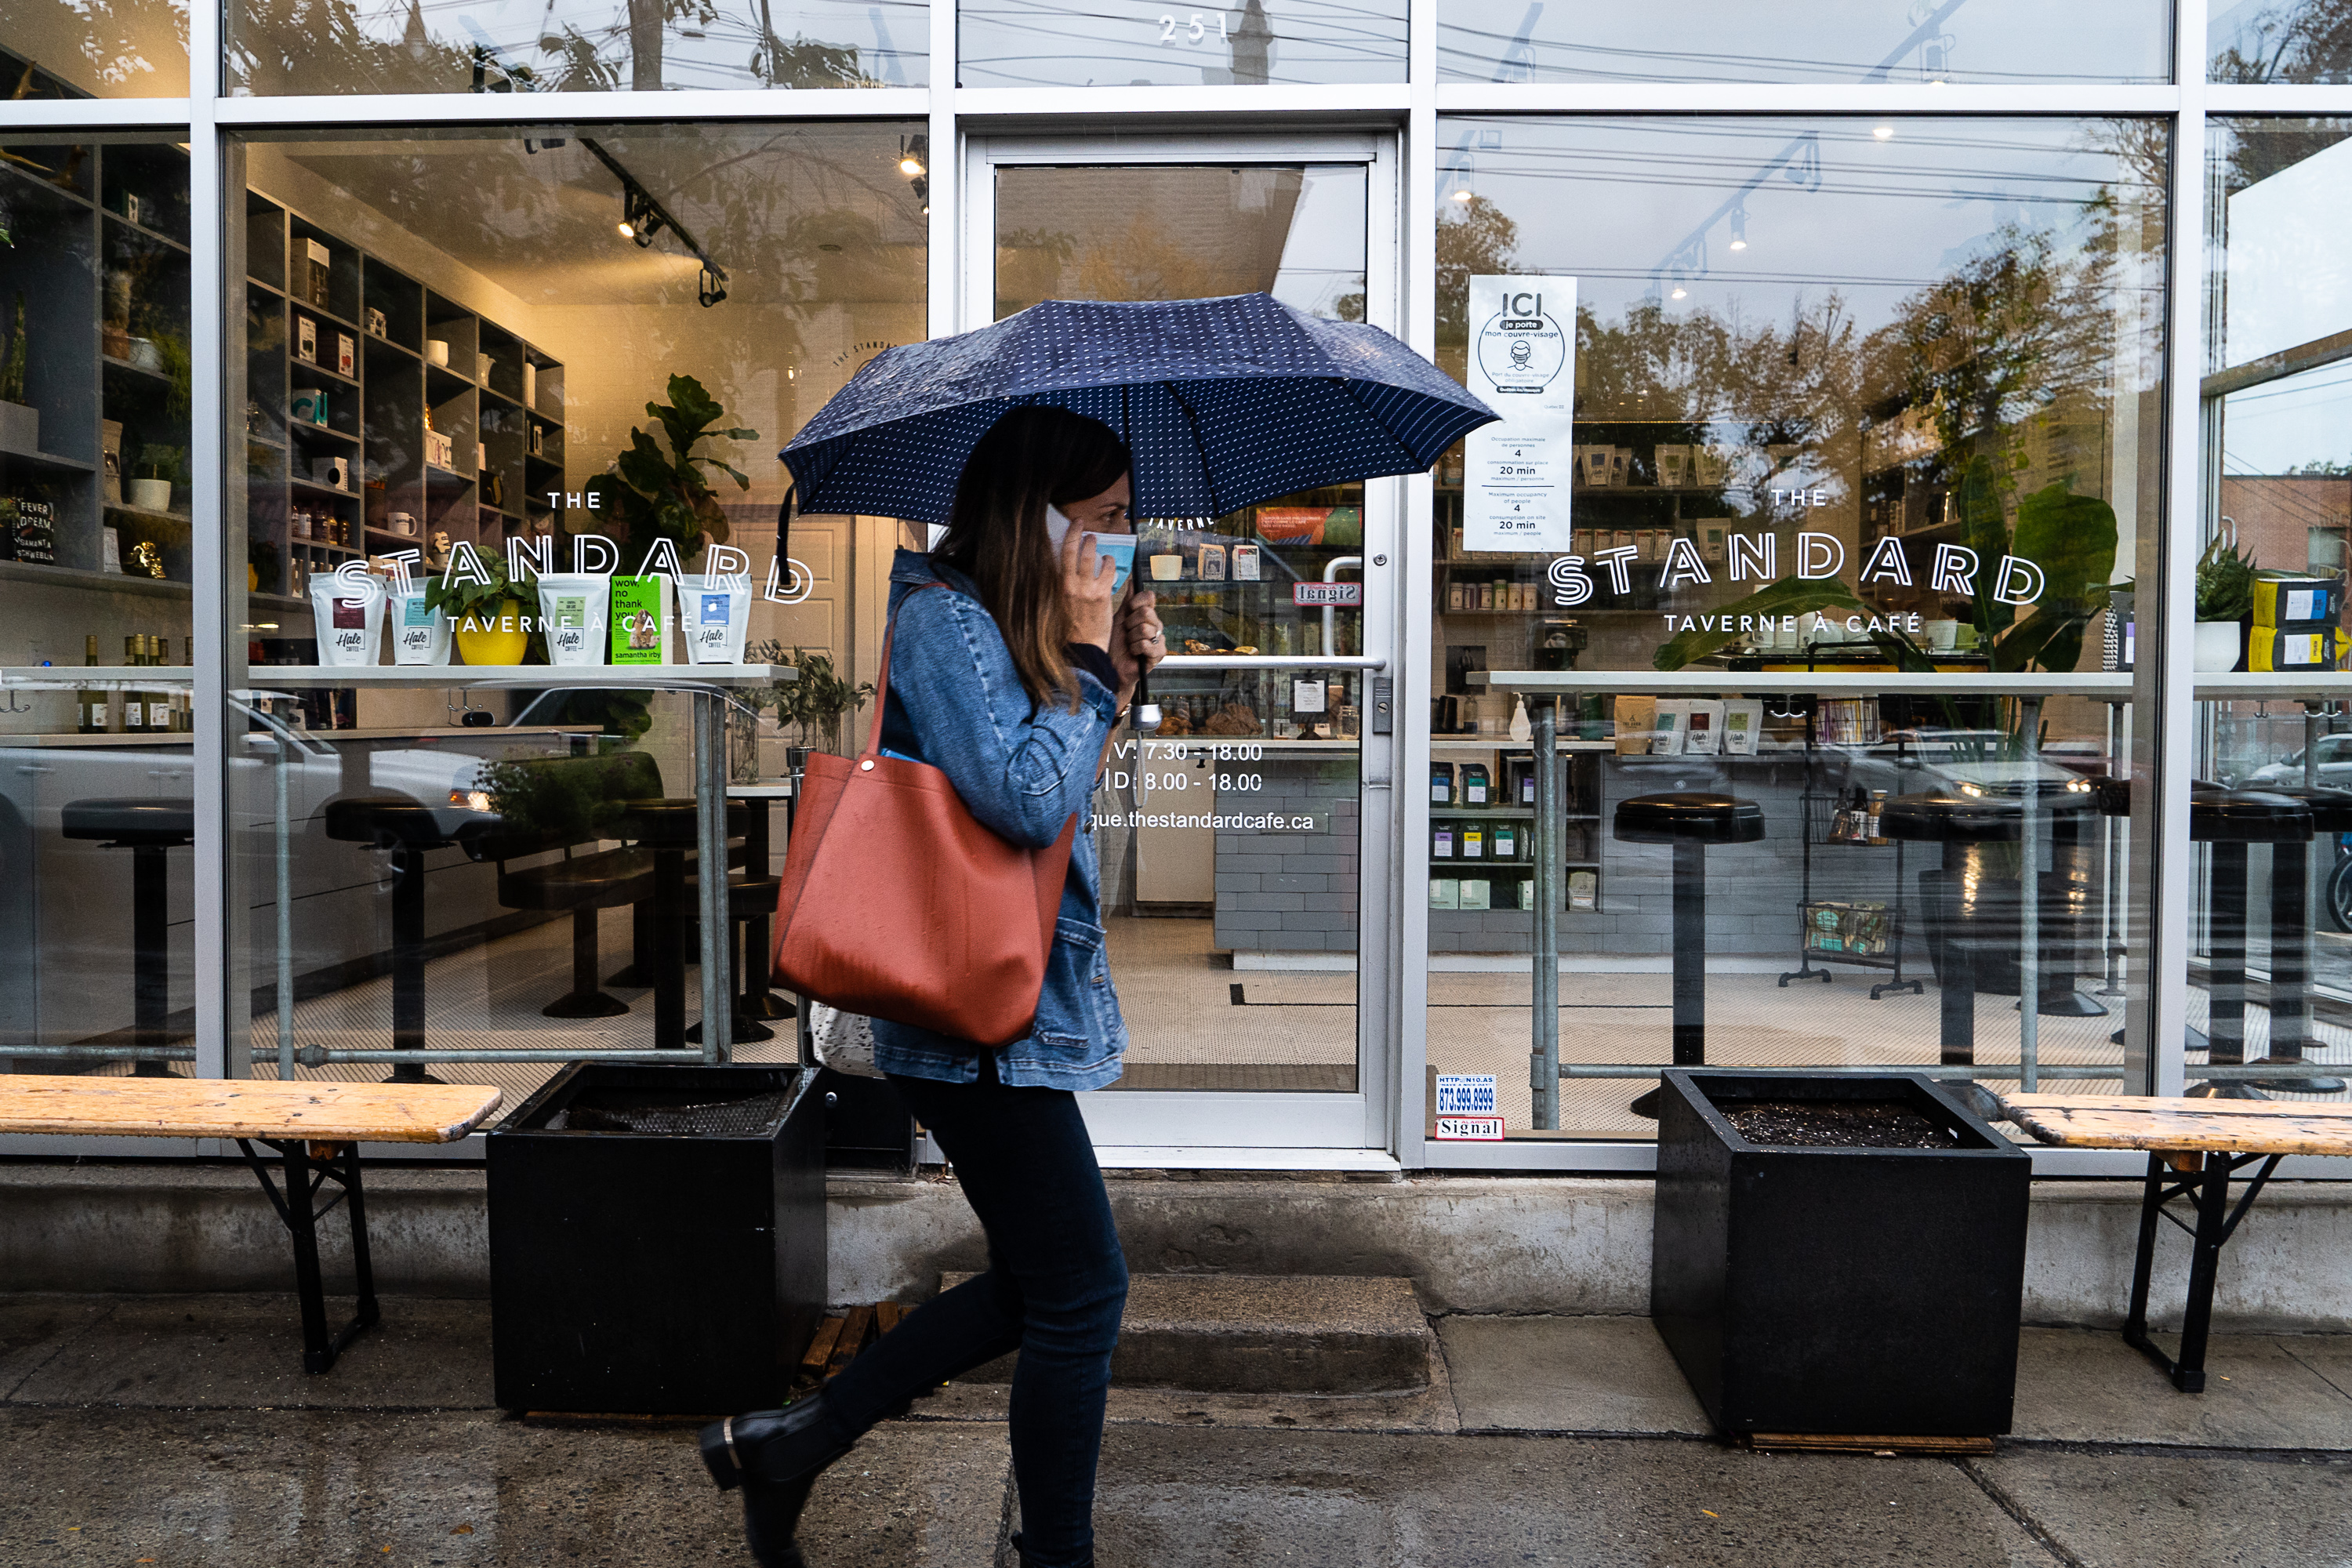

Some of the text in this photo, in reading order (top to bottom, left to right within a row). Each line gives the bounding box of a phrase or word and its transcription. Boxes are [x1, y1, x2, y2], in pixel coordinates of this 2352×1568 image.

[1160, 13, 1226, 40] 251
[1502, 293, 1541, 317] ICI
[1505, 321, 1537, 329] je porte
[833, 352, 848, 366] THE
[548, 492, 600, 508] THE
[1771, 489, 1826, 506] THE
[21, 502, 48, 515] FEVER
[17, 550, 54, 561] SCHWEBLIN
[334, 534, 814, 608] STANDARD
[1548, 532, 2045, 606] STANDARD
[446, 612, 693, 633] TAVERNE À CAFÉ
[1664, 612, 1919, 633] TAVERNE À CAFÉ
[336, 633, 361, 647] Hale
[403, 631, 426, 645] Hale
[557, 633, 579, 647] Hale
[699, 630, 724, 643] Hale
[1146, 742, 1188, 760] 7.30
[1210, 743, 1262, 760] 18.00
[1145, 772, 1188, 790] 8.00
[1209, 773, 1262, 791] 18.00
[1439, 1087, 1493, 1111] 873.999.8999
[1442, 1120, 1497, 1136] Signal
